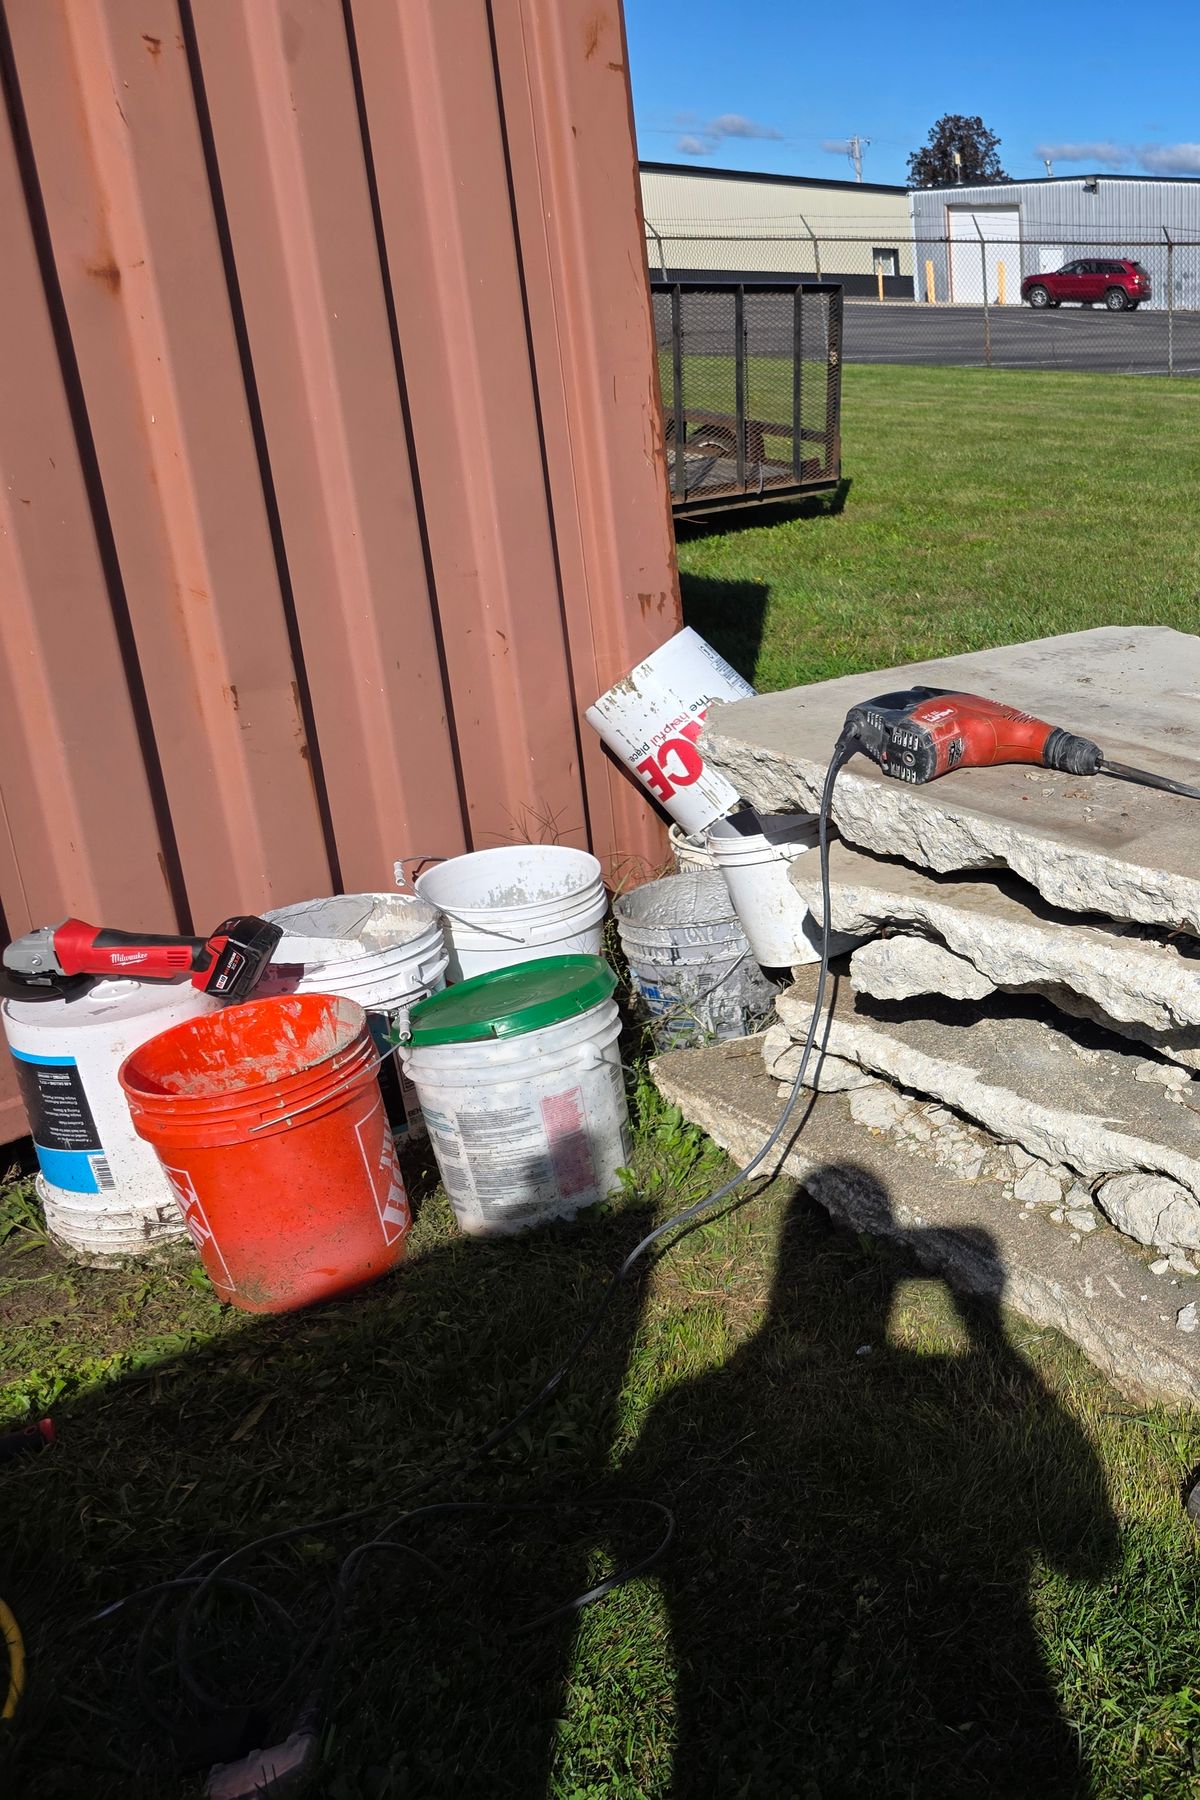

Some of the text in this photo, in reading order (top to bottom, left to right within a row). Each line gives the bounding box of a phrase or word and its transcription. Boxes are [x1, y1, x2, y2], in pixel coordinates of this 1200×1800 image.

[689, 694, 714, 712] The
[650, 711, 690, 747] helpful
[636, 708, 712, 803] CE
[109, 951, 149, 964] Milwaukee
